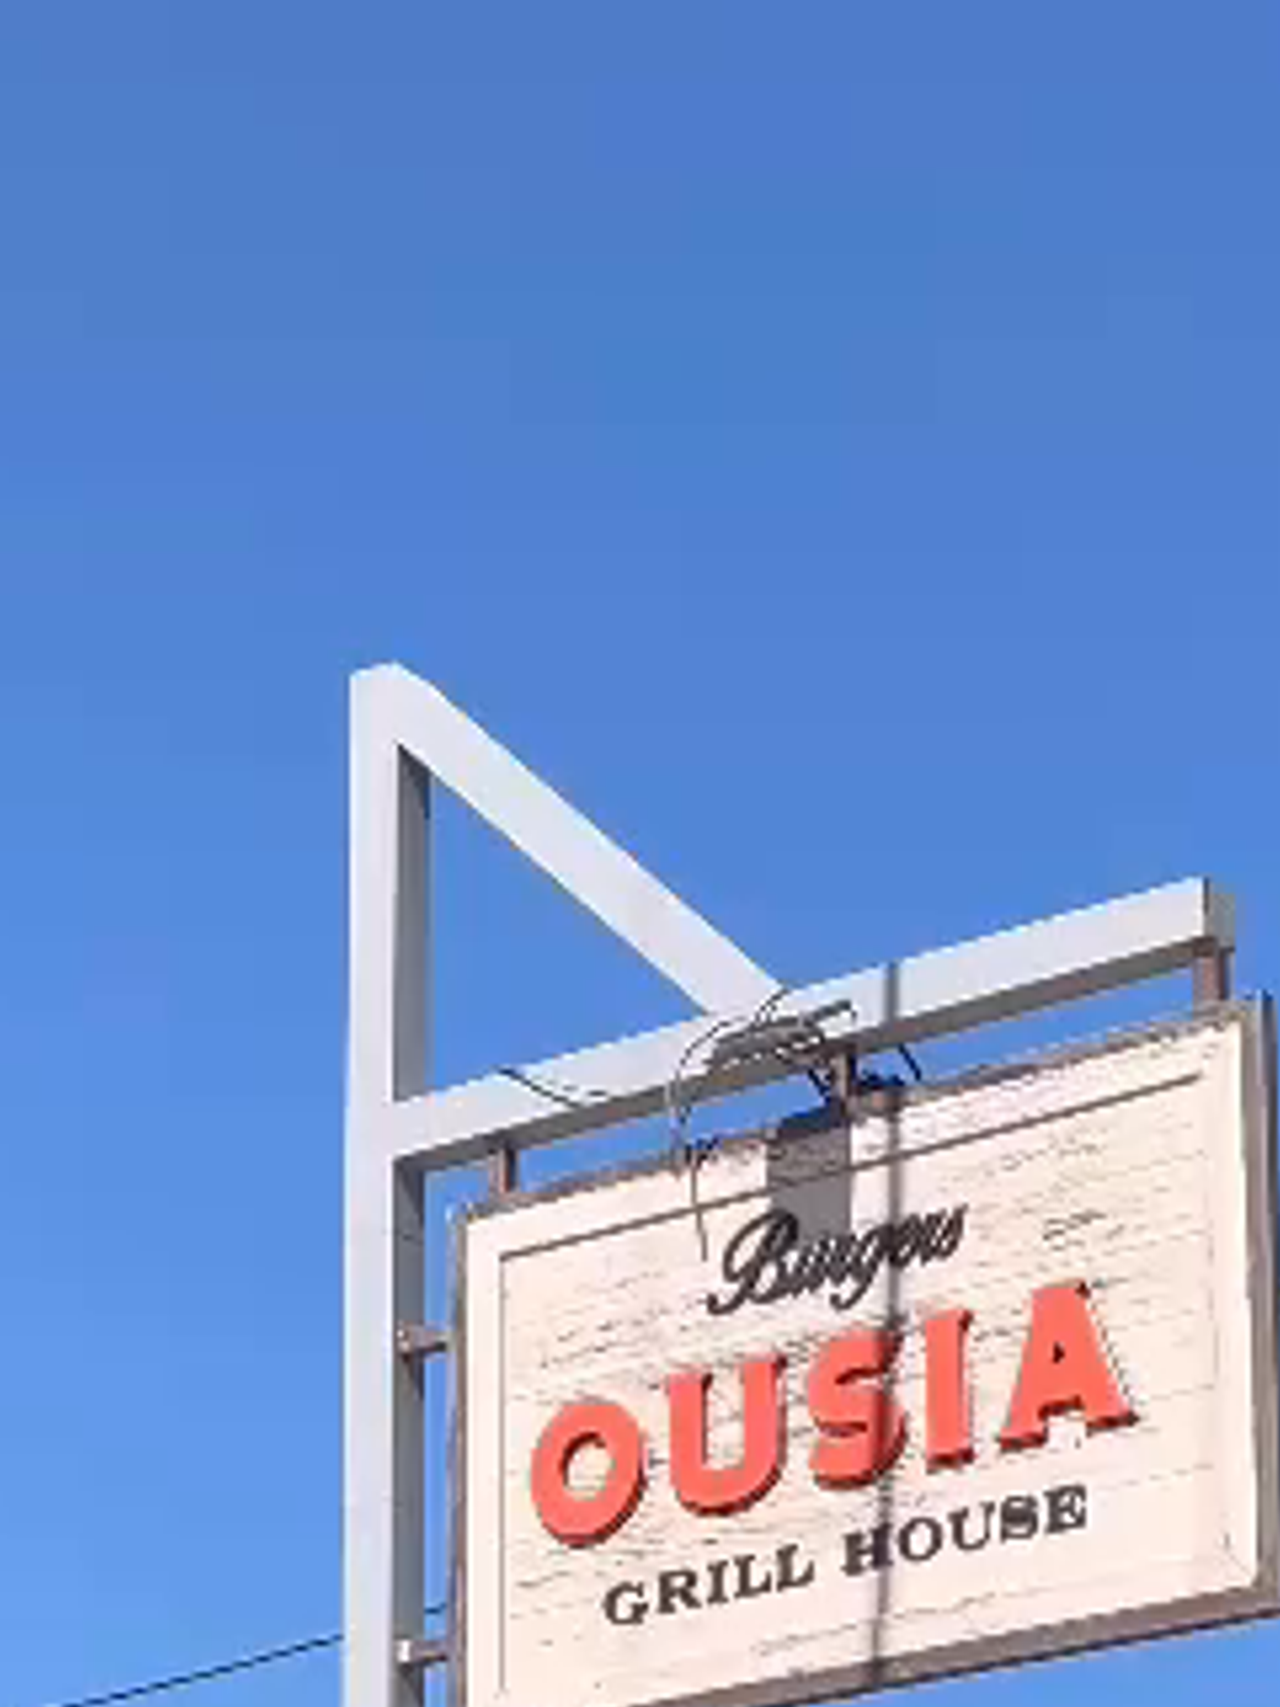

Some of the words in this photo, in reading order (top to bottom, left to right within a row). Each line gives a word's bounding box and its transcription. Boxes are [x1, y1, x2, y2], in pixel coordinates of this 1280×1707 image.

[706, 1204, 969, 1315] Burgers
[530, 1282, 1139, 1549] OUSIA
[603, 1544, 815, 1625] GRILL
[841, 1484, 1087, 1577] HOUSE
